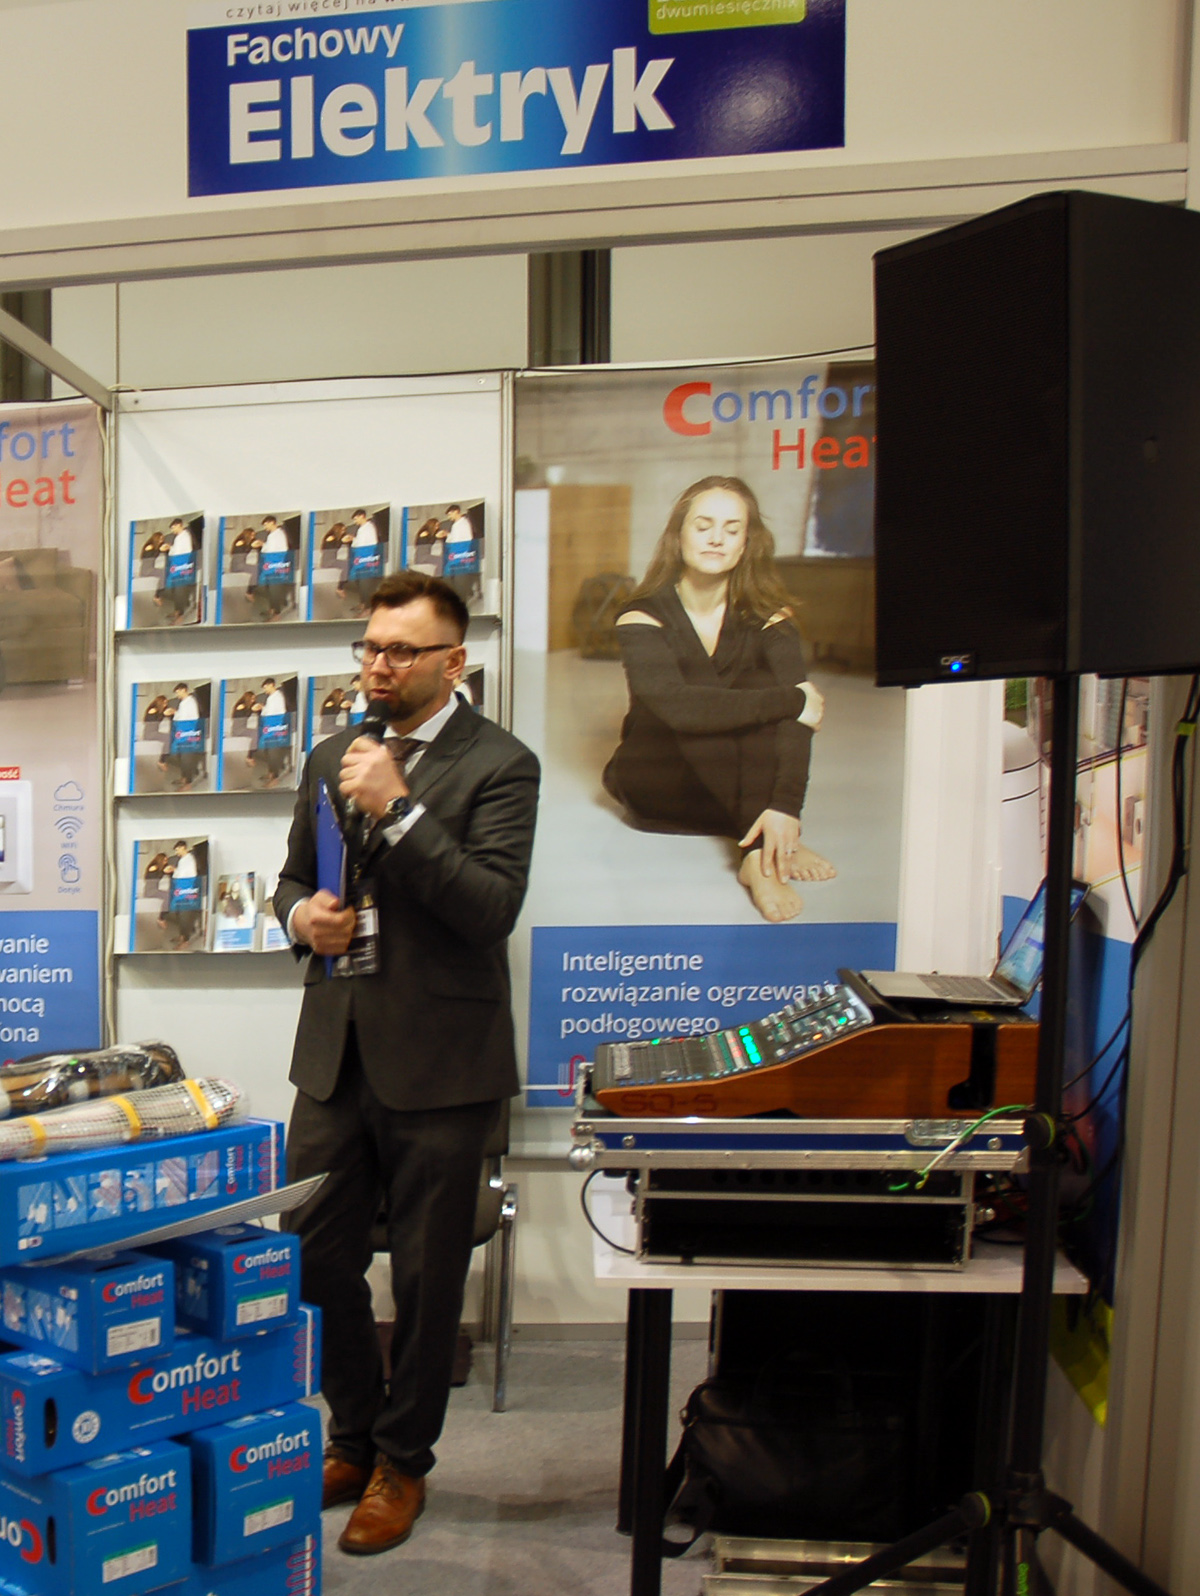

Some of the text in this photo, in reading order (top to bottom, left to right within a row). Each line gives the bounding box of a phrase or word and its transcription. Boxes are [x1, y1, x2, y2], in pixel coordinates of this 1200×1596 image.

[226, 1, 281, 19] czytaj
[227, 23, 405, 66] Fachowy
[228, 46, 676, 164] Elektryk
[662, 374, 878, 437] Comfor
[771, 428, 878, 470] Hea
[562, 950, 704, 977] Inteligentne
[561, 981, 701, 1007] rozwiązanie
[560, 1014, 721, 1038] podłogowego
[232, 1246, 291, 1274] Comfort
[260, 1262, 291, 1280] Heat
[102, 1273, 164, 1303] Comfort
[131, 1289, 164, 1310] Heat
[128, 1348, 241, 1405] Comfort
[182, 1378, 241, 1416] Heat
[11, 1388, 27, 1463] Comfort
[228, 1429, 311, 1473] Comfort
[267, 1451, 311, 1480] Heat
[86, 1469, 177, 1517] Comfort
[129, 1491, 177, 1522] Heat
